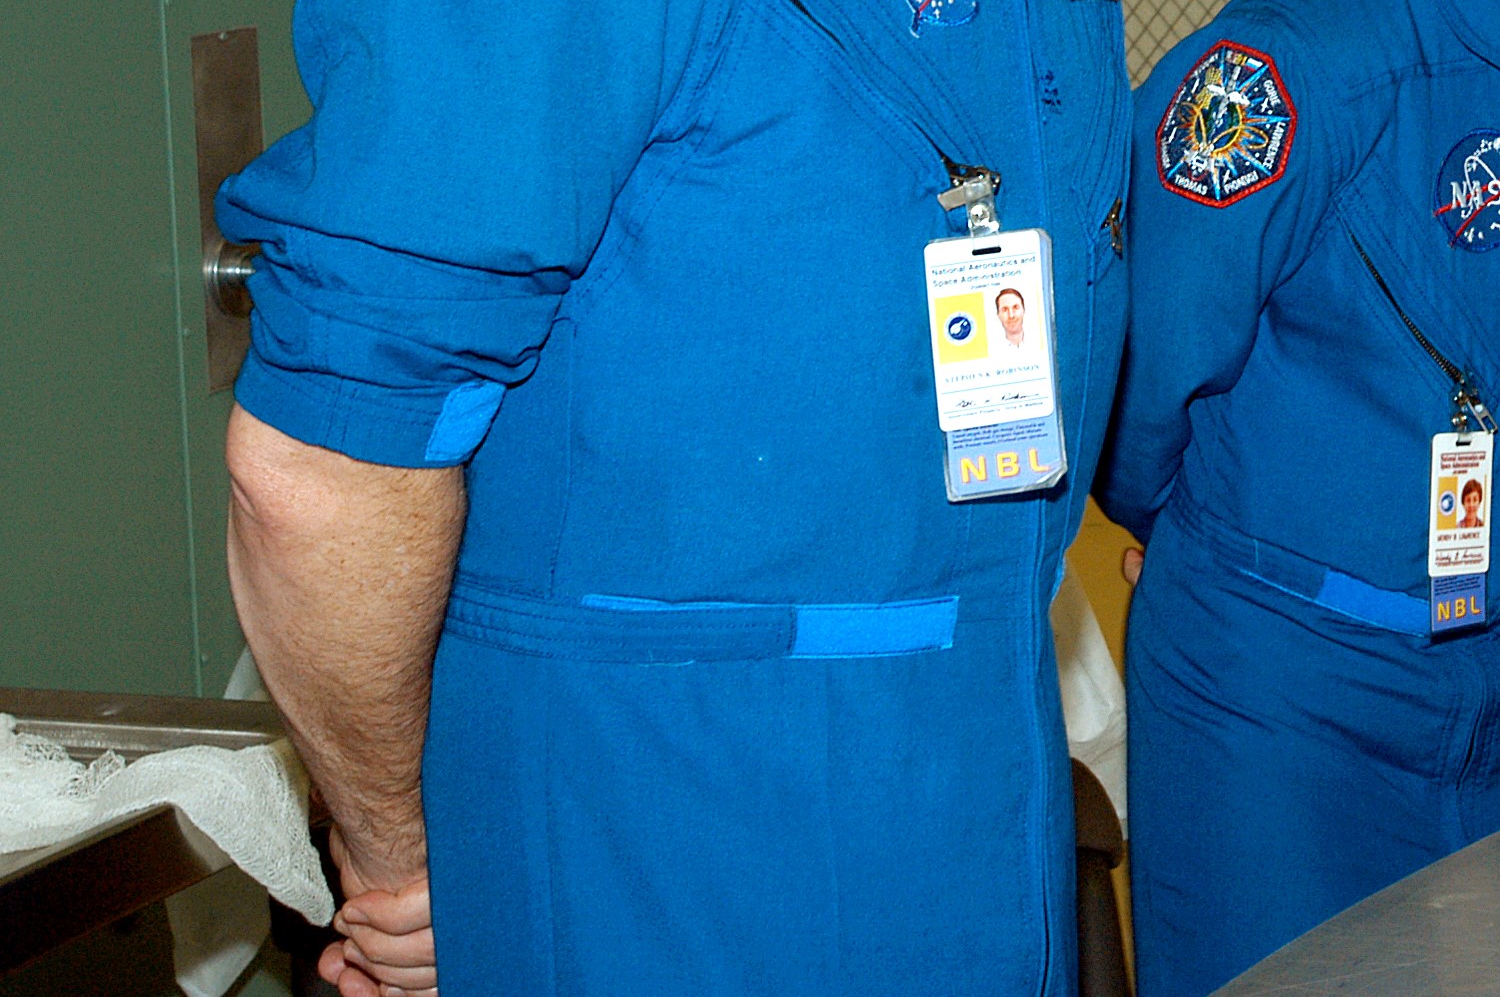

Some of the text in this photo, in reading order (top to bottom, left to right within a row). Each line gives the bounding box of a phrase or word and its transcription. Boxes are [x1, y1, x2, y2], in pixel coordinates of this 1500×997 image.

[1263, 79, 1281, 106] GORIE
[1262, 121, 1286, 170] LAWRENCE
[1174, 173, 1209, 196] THOMAS
[931, 255, 1036, 276] National Aeronautics and
[932, 277, 958, 288] Space
[960, 269, 1022, 283] Administration
[960, 448, 1051, 484] NBL
[1437, 595, 1482, 622] NBL
